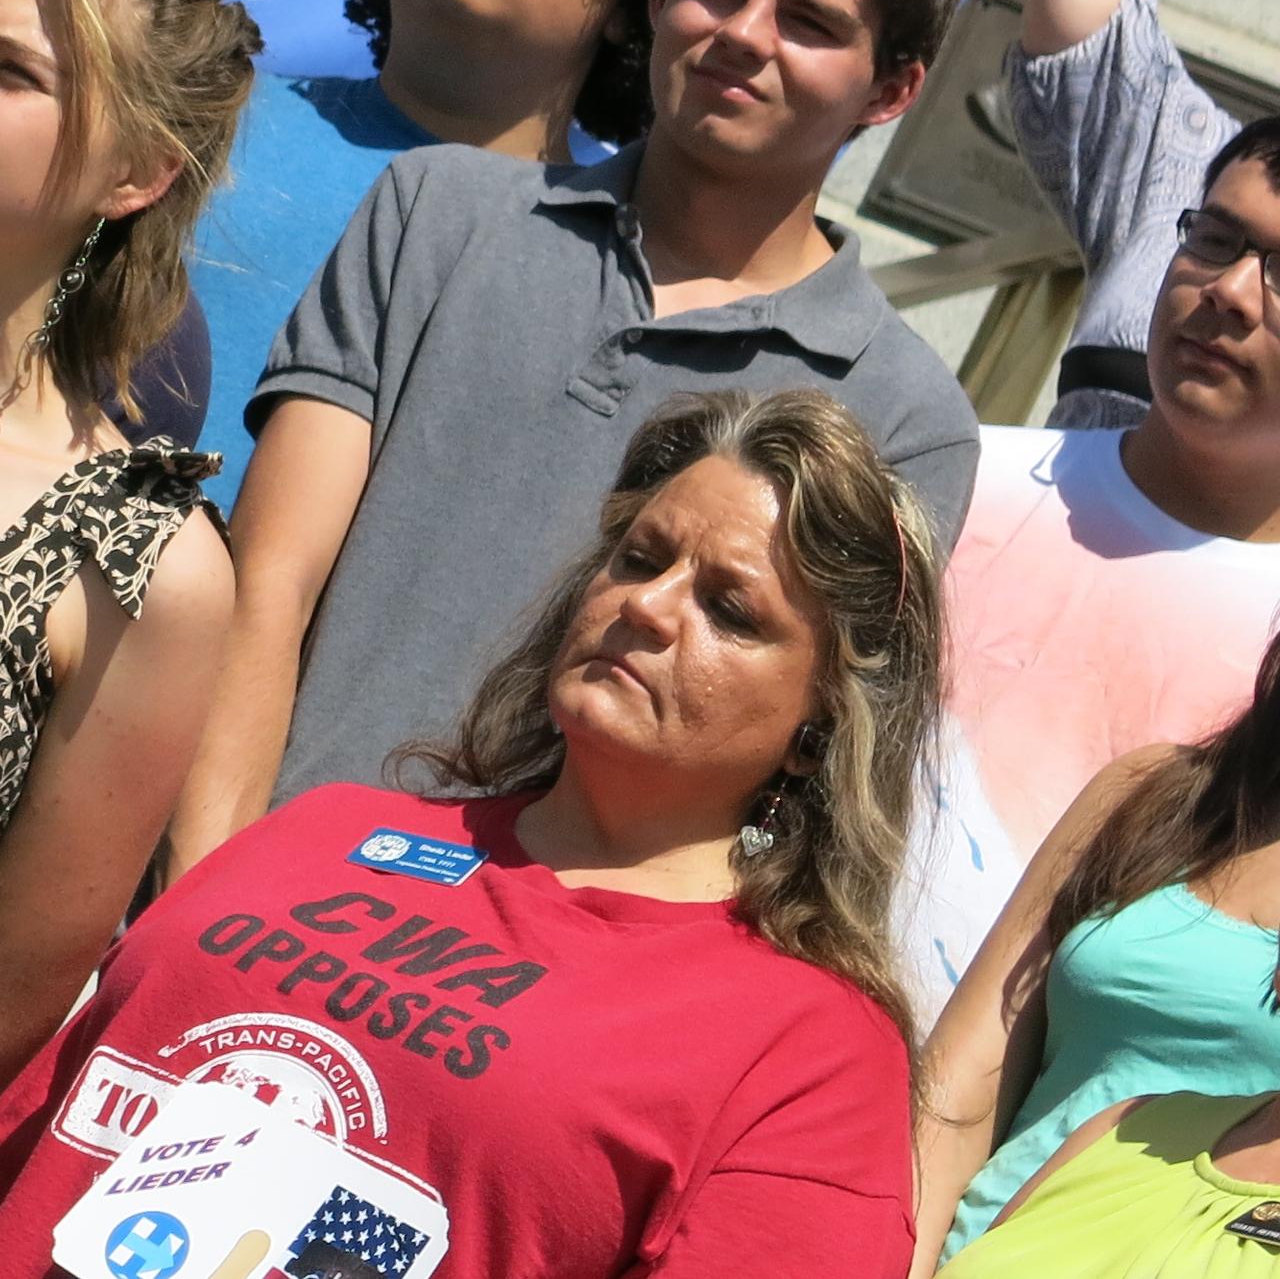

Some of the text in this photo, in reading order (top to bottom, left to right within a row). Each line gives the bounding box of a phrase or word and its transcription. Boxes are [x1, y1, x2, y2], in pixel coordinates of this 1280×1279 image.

[198, 913, 512, 1080] OPPOSES
[290, 892, 550, 1009] CWA
[199, 1029, 366, 1132] TRANS-PACIFIC
[104, 1161, 232, 1196] LIEDER
[139, 1127, 262, 1164] VOTE 4
